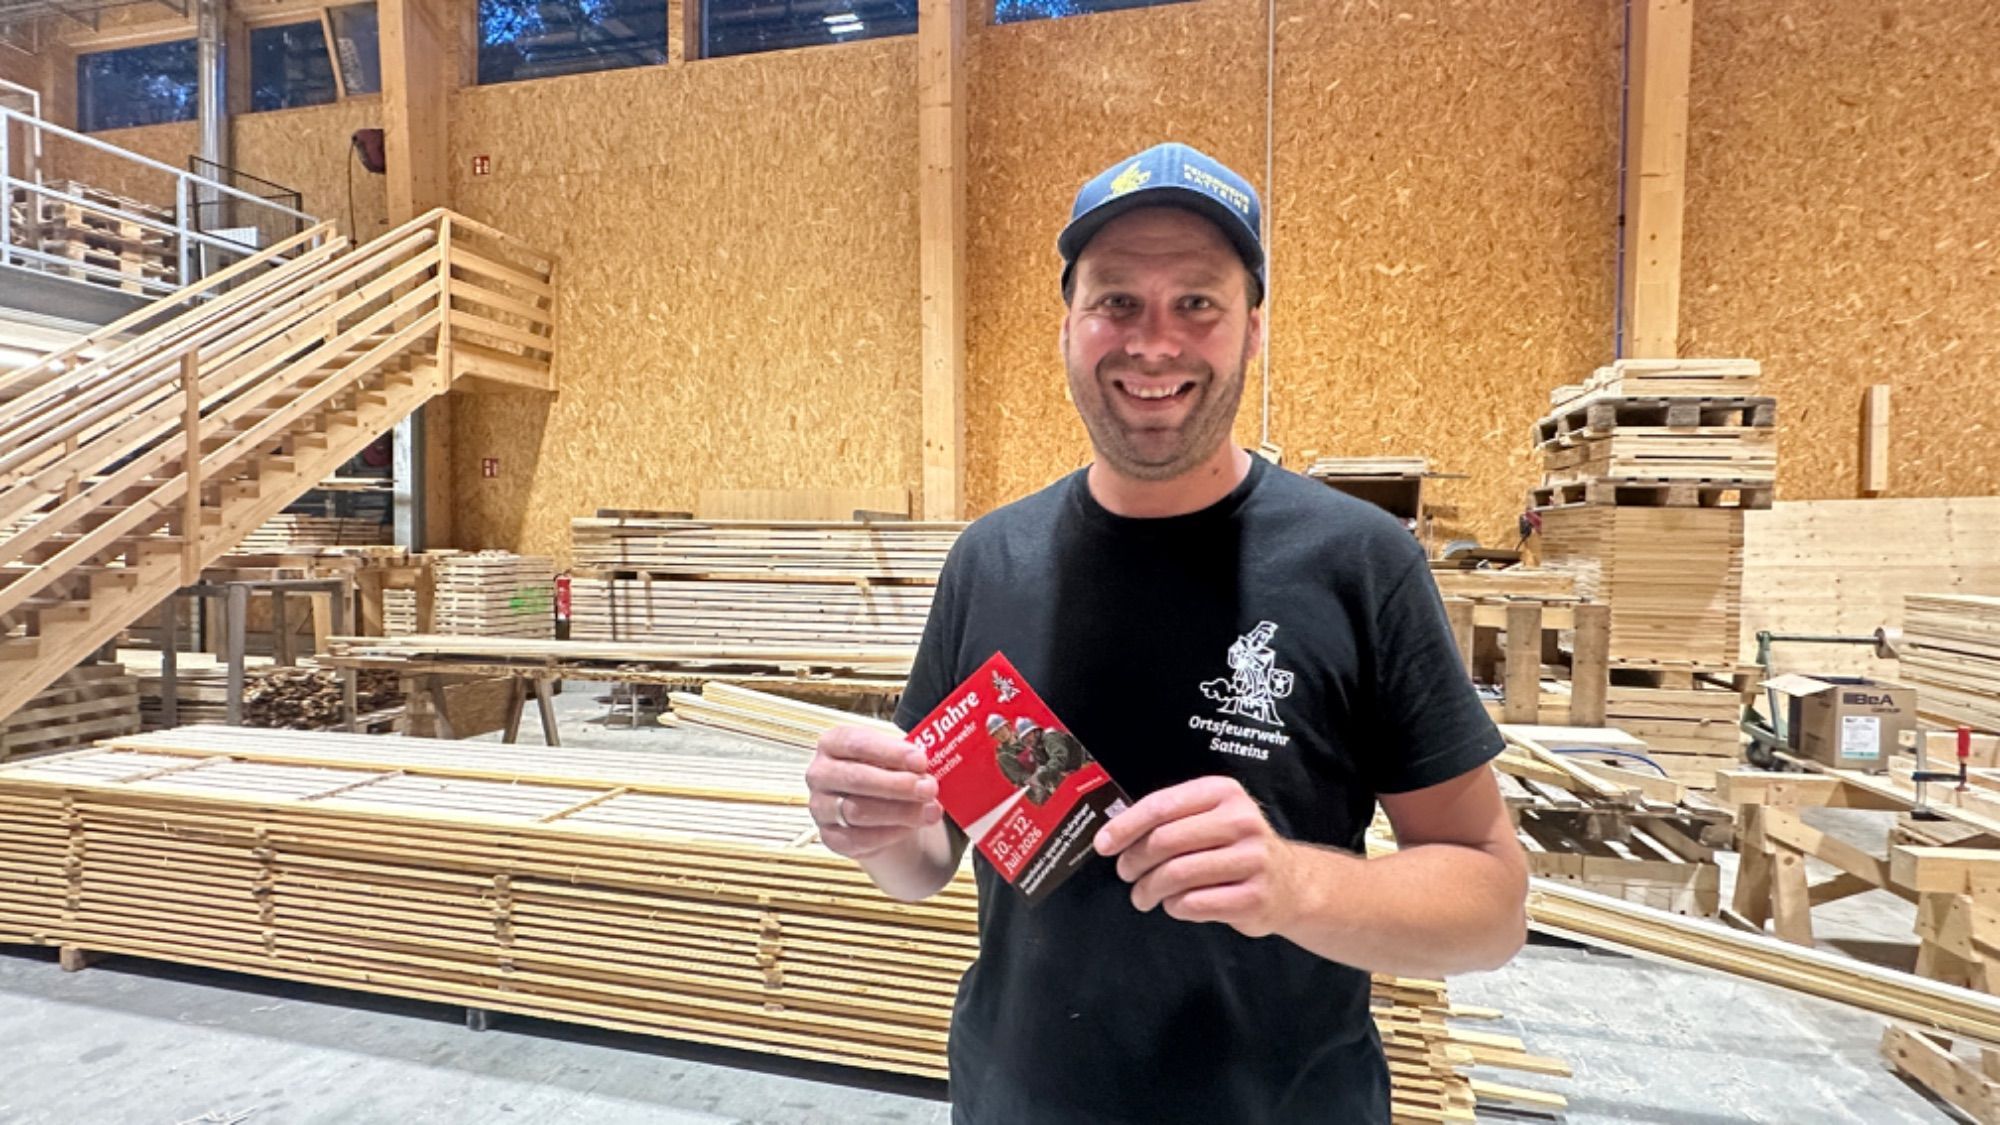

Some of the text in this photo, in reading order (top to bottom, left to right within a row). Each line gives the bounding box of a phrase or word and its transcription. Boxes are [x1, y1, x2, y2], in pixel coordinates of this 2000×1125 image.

[932, 691, 980, 743] Jahre
[1188, 715, 1291, 746] Ortsfeuerwehr
[1209, 737, 1270, 761] Satteins
[992, 841, 1013, 862] 10.
[1013, 816, 1034, 837] 12.
[1003, 848, 1023, 876] Juli
[1017, 826, 1043, 856] 2026
